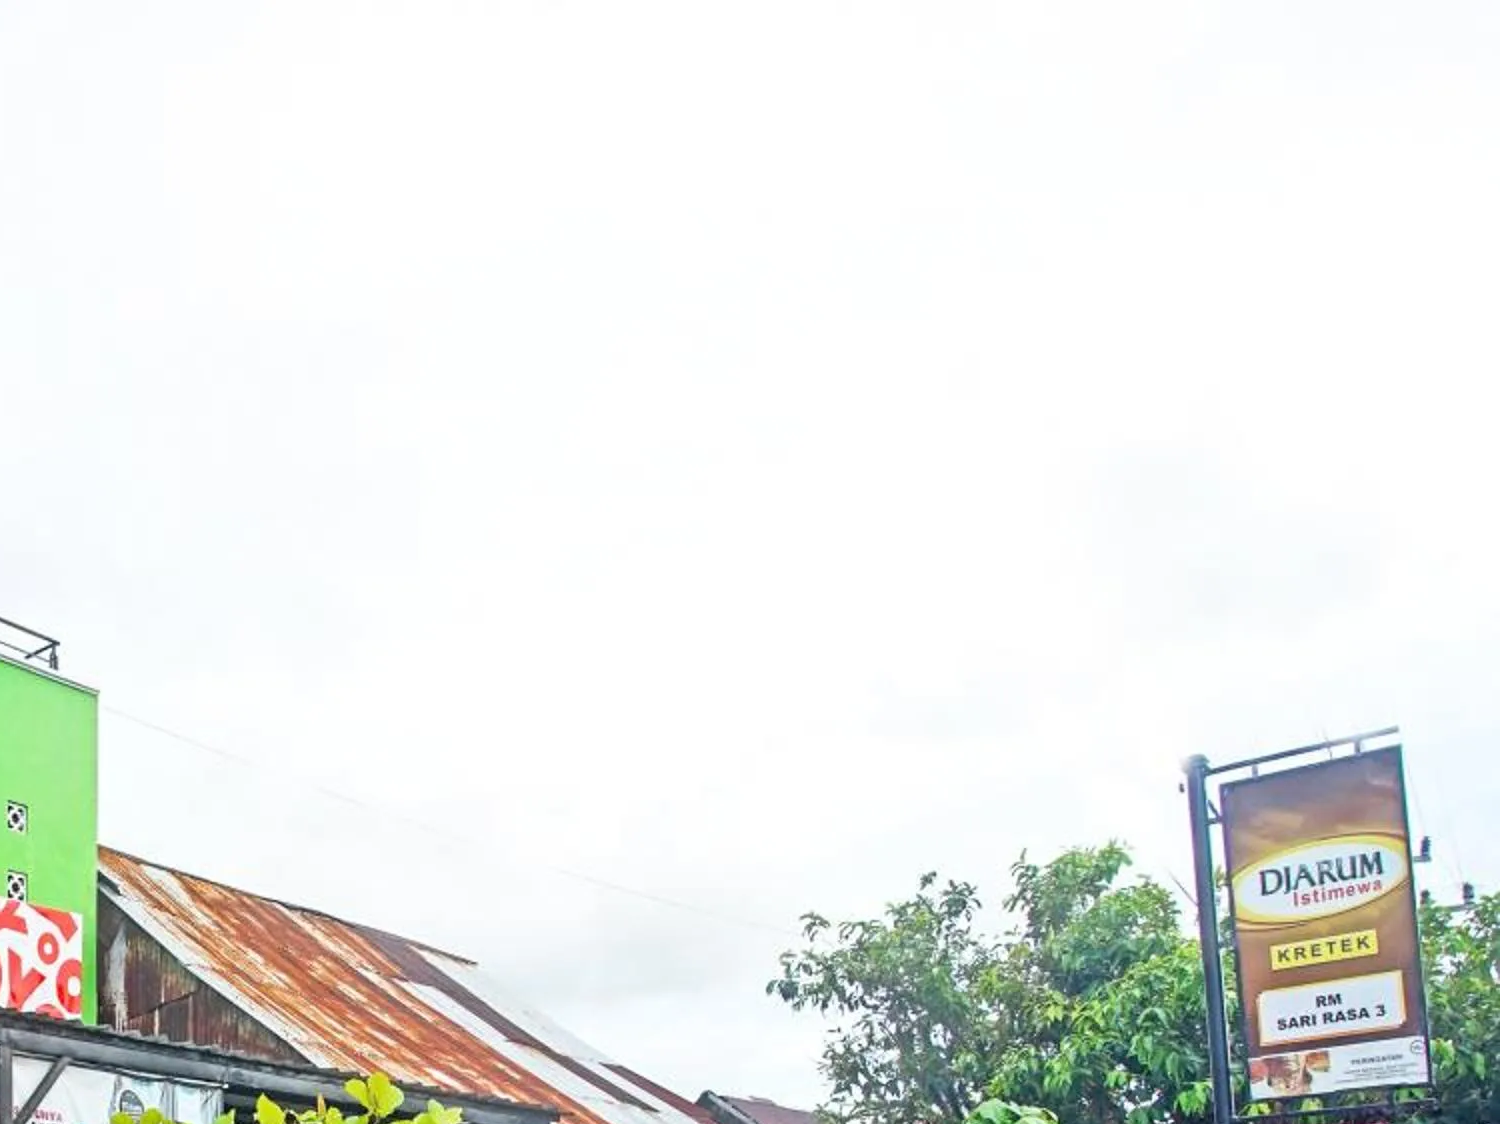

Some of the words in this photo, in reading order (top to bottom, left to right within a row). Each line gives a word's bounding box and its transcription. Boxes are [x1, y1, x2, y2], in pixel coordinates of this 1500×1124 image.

[1259, 851, 1384, 897] DJARUM
[1293, 879, 1382, 907] Istimewa
[1277, 935, 1370, 963] KRETEK
[1315, 993, 1342, 1008] RM
[1277, 1014, 1317, 1031] SARI
[1323, 1007, 1370, 1024] RASA
[1375, 1004, 1386, 1017] 3
